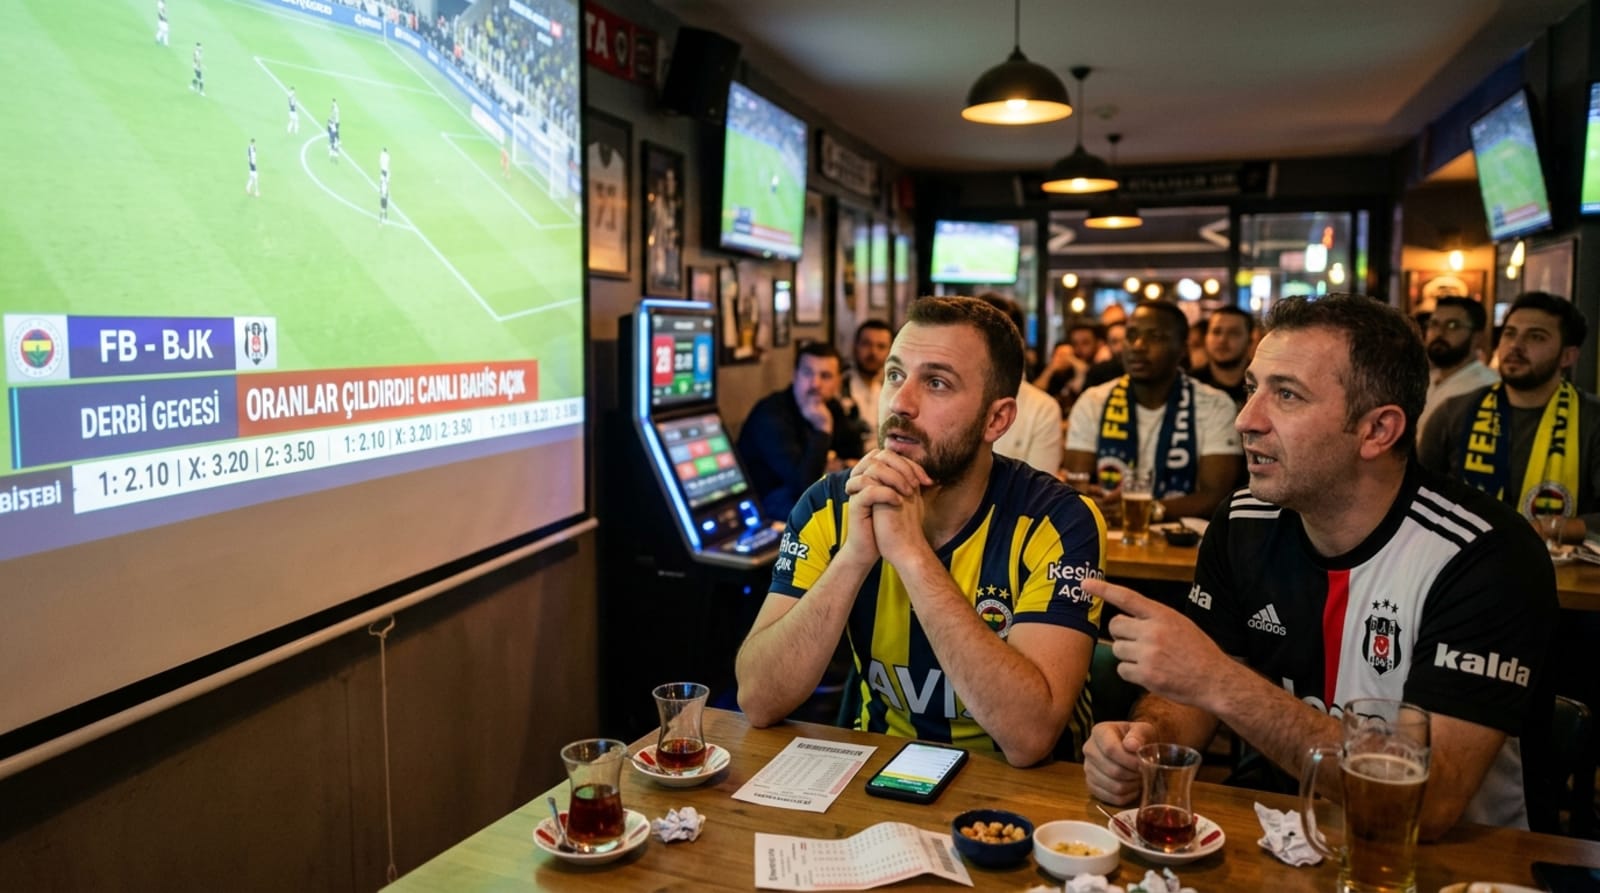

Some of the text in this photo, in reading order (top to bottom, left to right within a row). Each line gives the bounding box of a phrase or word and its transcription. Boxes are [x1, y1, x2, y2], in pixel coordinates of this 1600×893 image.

[99, 329, 138, 363] FB
[162, 329, 214, 360] BJK
[80, 389, 220, 439] DERBİ GECESİ
[246, 366, 526, 421] ORANLAR ÇILDIRDI! CANLI BAHİS AÇIK
[359, 430, 385, 451] 2.10
[409, 424, 432, 443] 3.20
[125, 462, 169, 491] 2.10
[189, 456, 207, 480] X:
[212, 450, 249, 476] 3.20
[284, 440, 316, 464] 3.50
[868, 659, 974, 719] AVI
[1433, 642, 1531, 688] kalda
